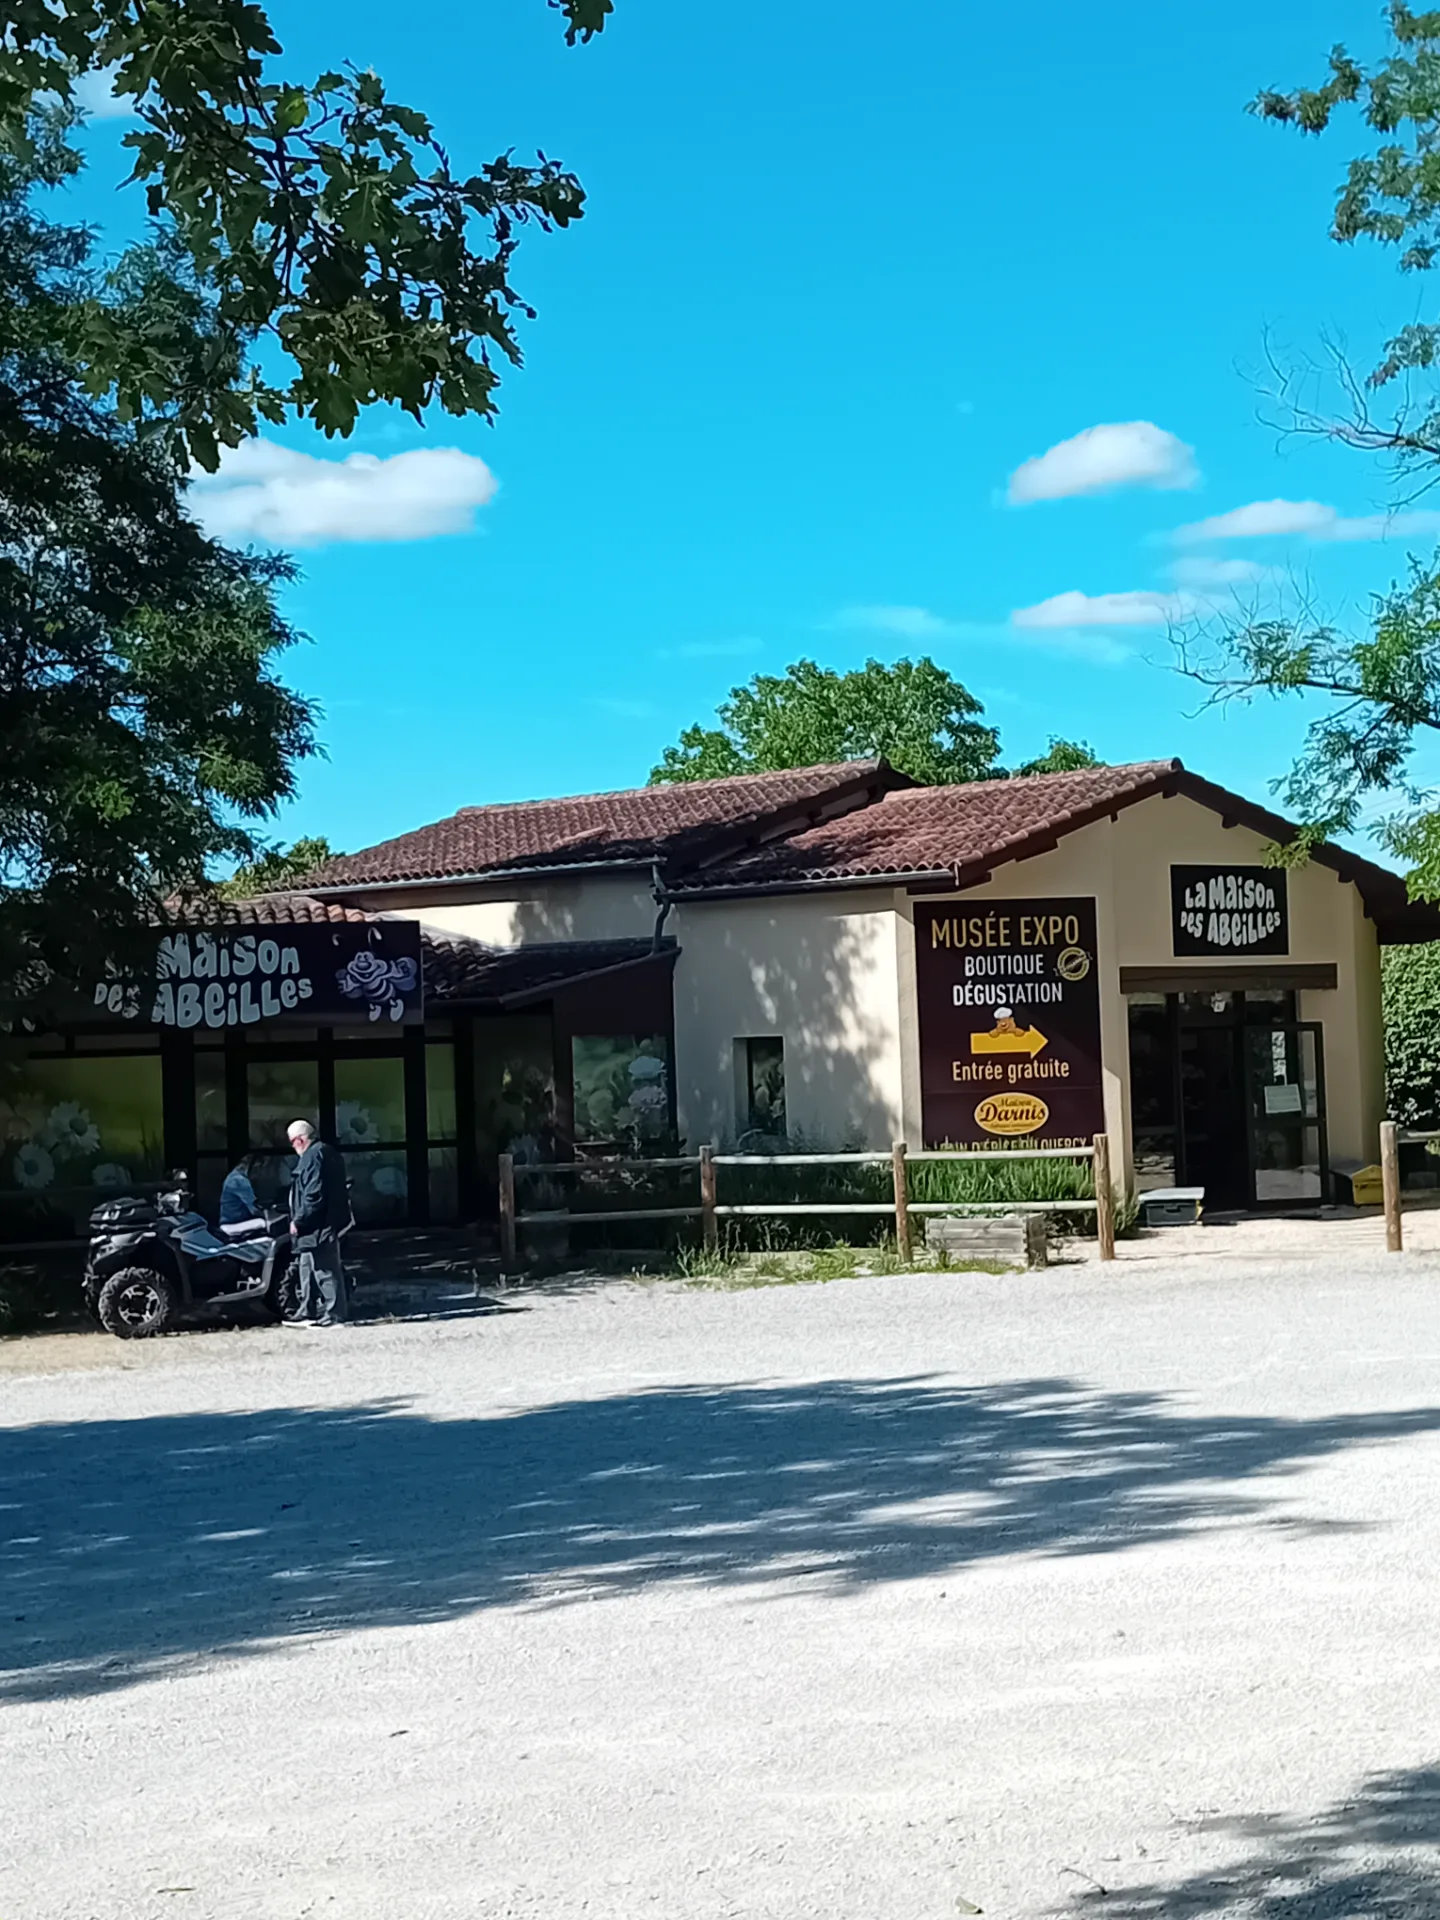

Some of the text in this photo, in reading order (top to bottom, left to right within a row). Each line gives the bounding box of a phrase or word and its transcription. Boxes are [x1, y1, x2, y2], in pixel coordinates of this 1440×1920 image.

[931, 911, 1080, 949] MUSÉE EXPO
[964, 954, 1044, 977] BOUTIQUE
[953, 981, 1063, 1006] DÉGUSTATION
[953, 1058, 1070, 1083] Entrée gratuite
[980, 1102, 1046, 1122] Darnis
